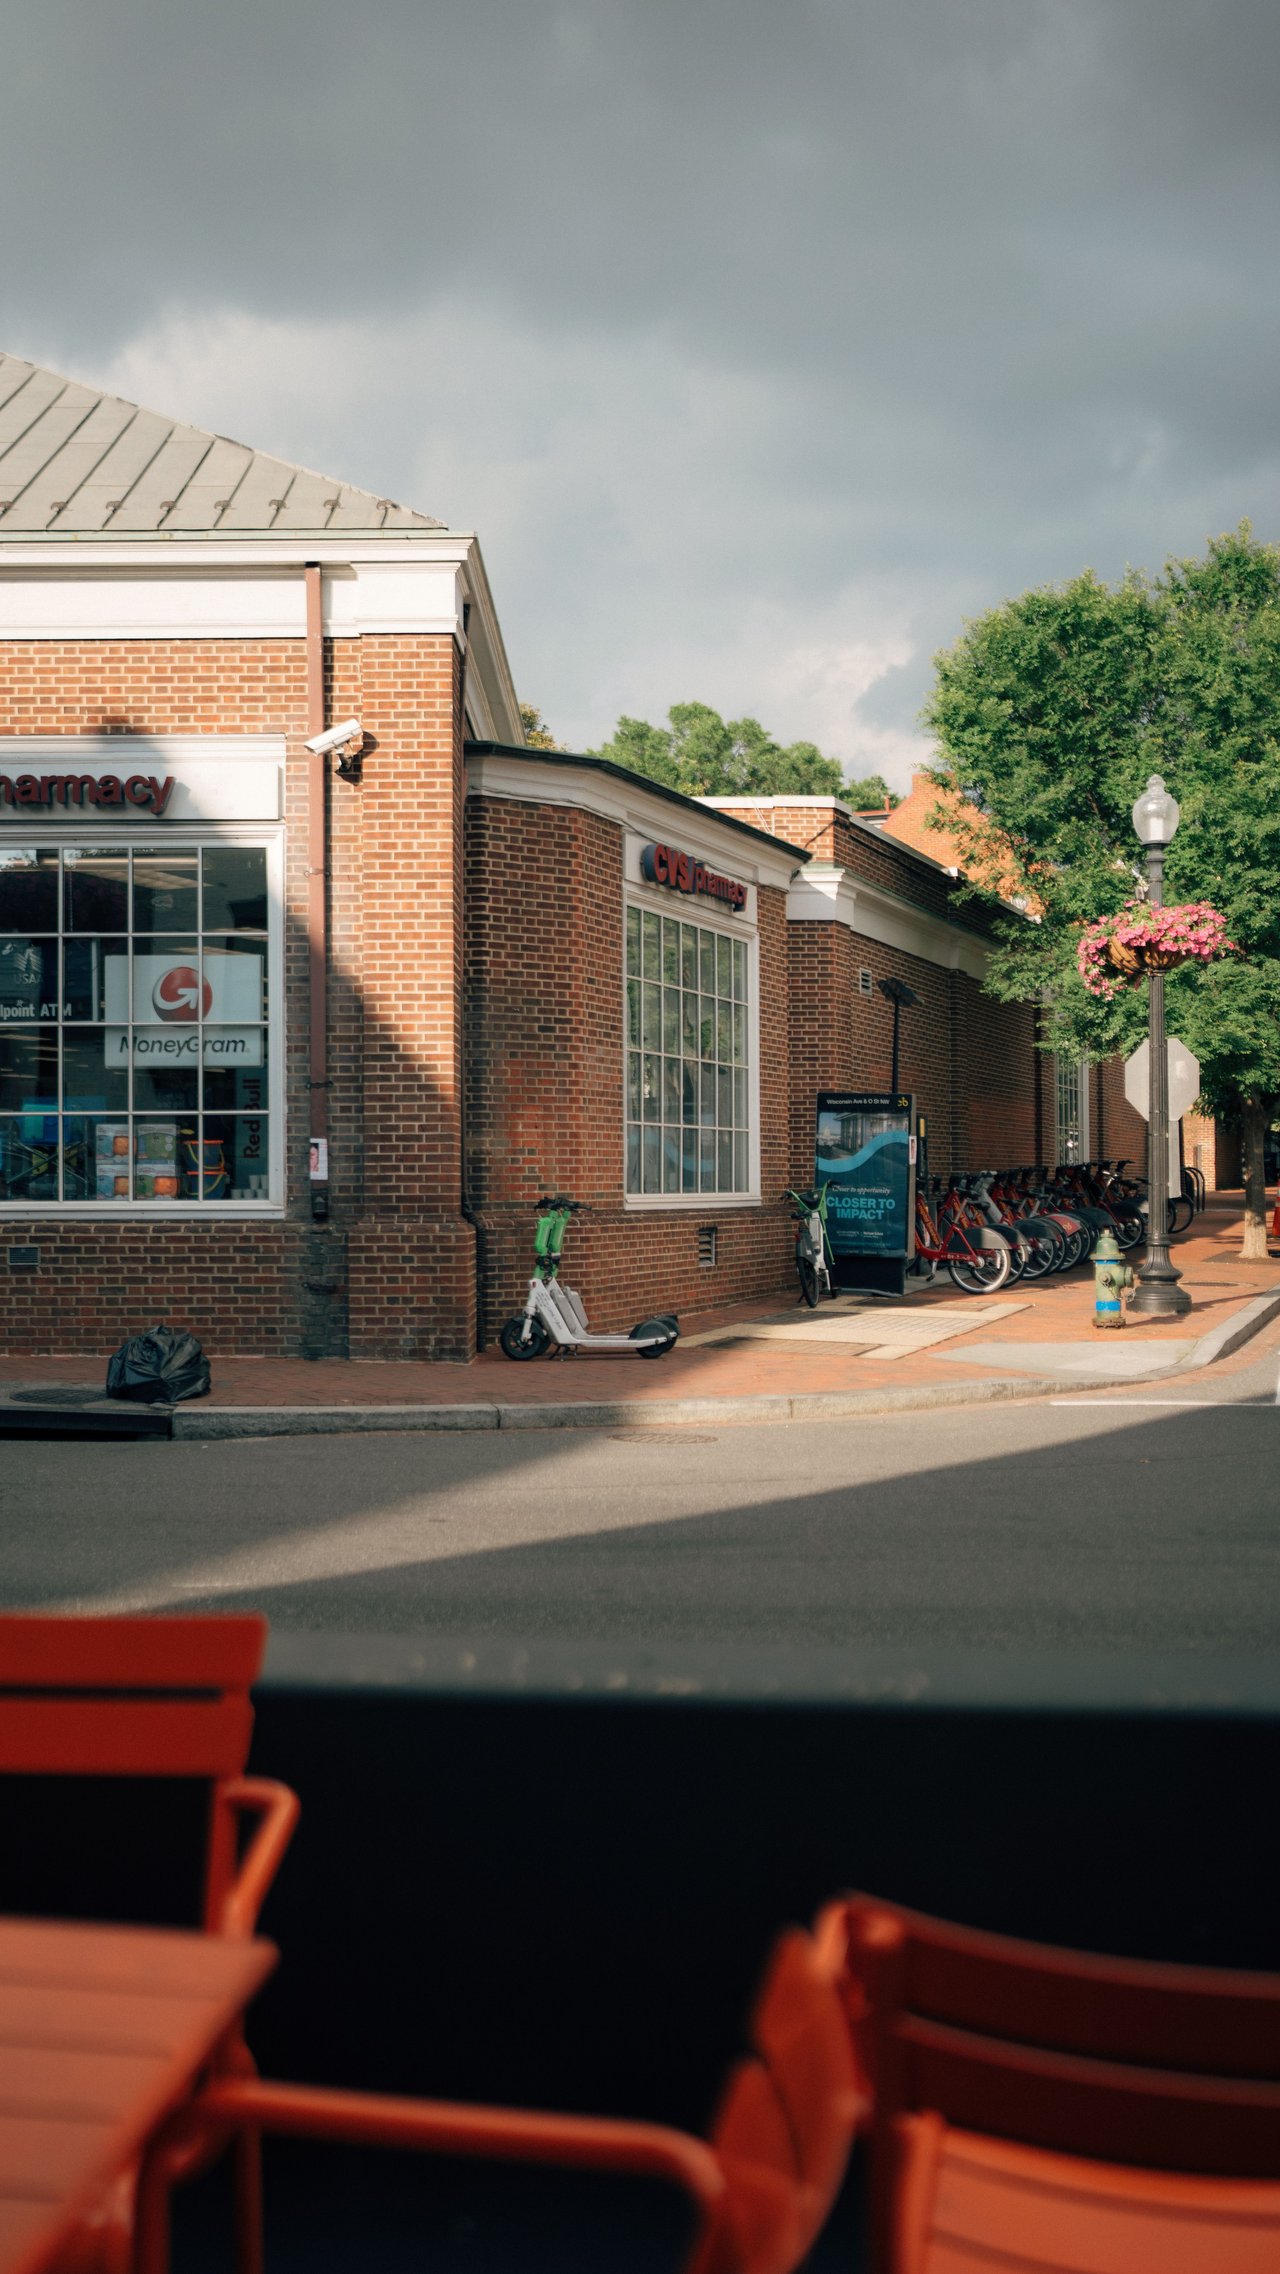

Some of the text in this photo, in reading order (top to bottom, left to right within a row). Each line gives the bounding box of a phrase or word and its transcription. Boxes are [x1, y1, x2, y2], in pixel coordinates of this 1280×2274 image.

[120, 1036, 246, 1057] MoneyGram
[242, 1079, 261, 1158] Red Bull
[827, 1197, 896, 1210] CLOSER TO
[836, 1208, 885, 1220] IMPACT
